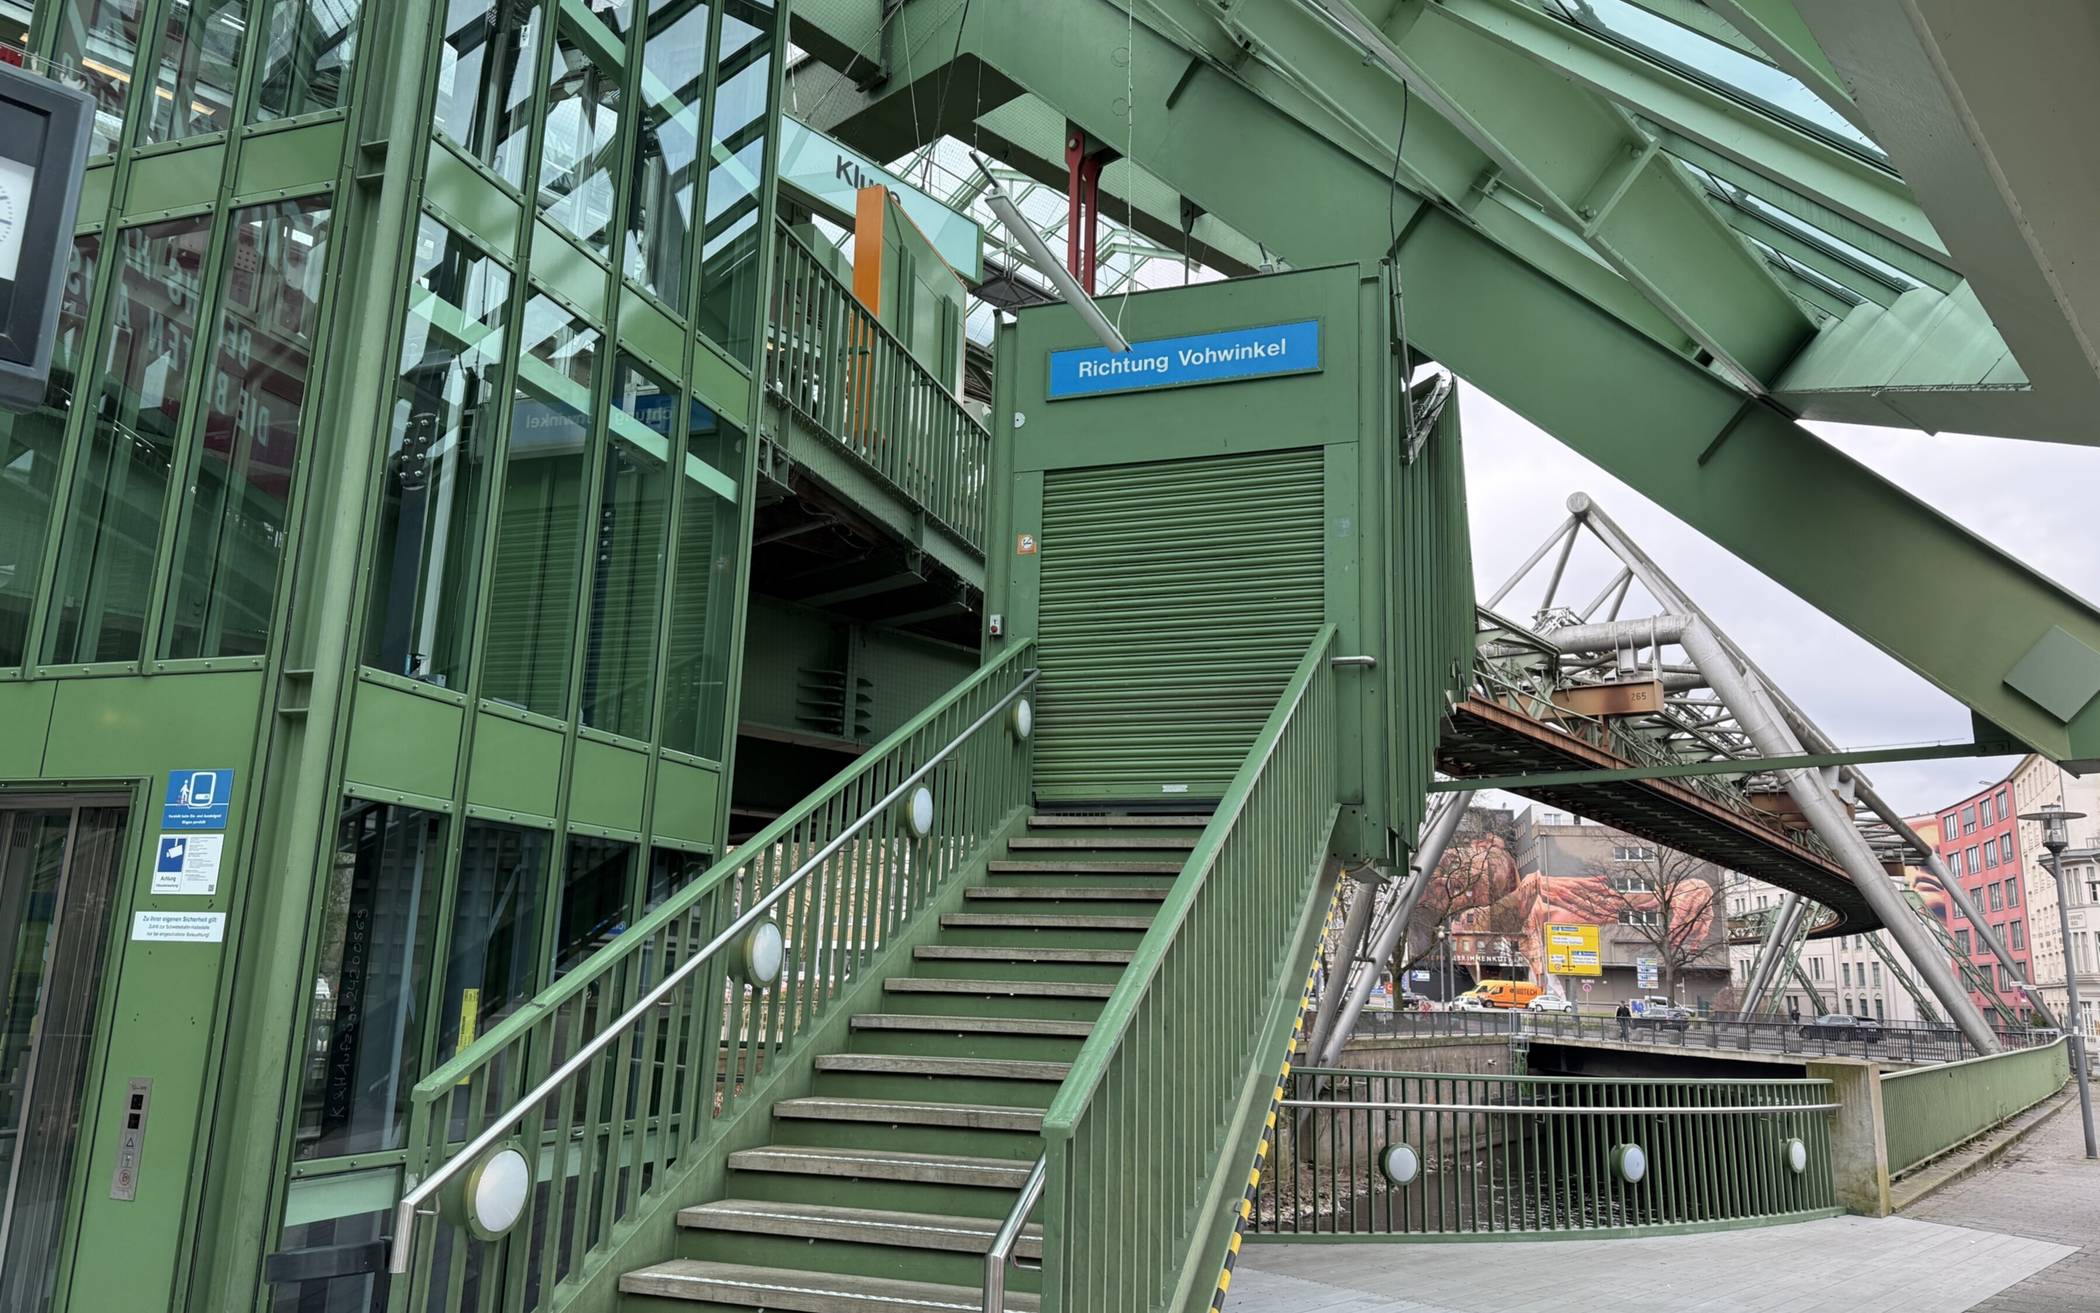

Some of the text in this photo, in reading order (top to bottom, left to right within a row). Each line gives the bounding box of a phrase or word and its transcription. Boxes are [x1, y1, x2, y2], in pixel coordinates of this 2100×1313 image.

[1079, 338, 1287, 378] Richtung Vohwinkel
[1631, 691, 1647, 701] 265
